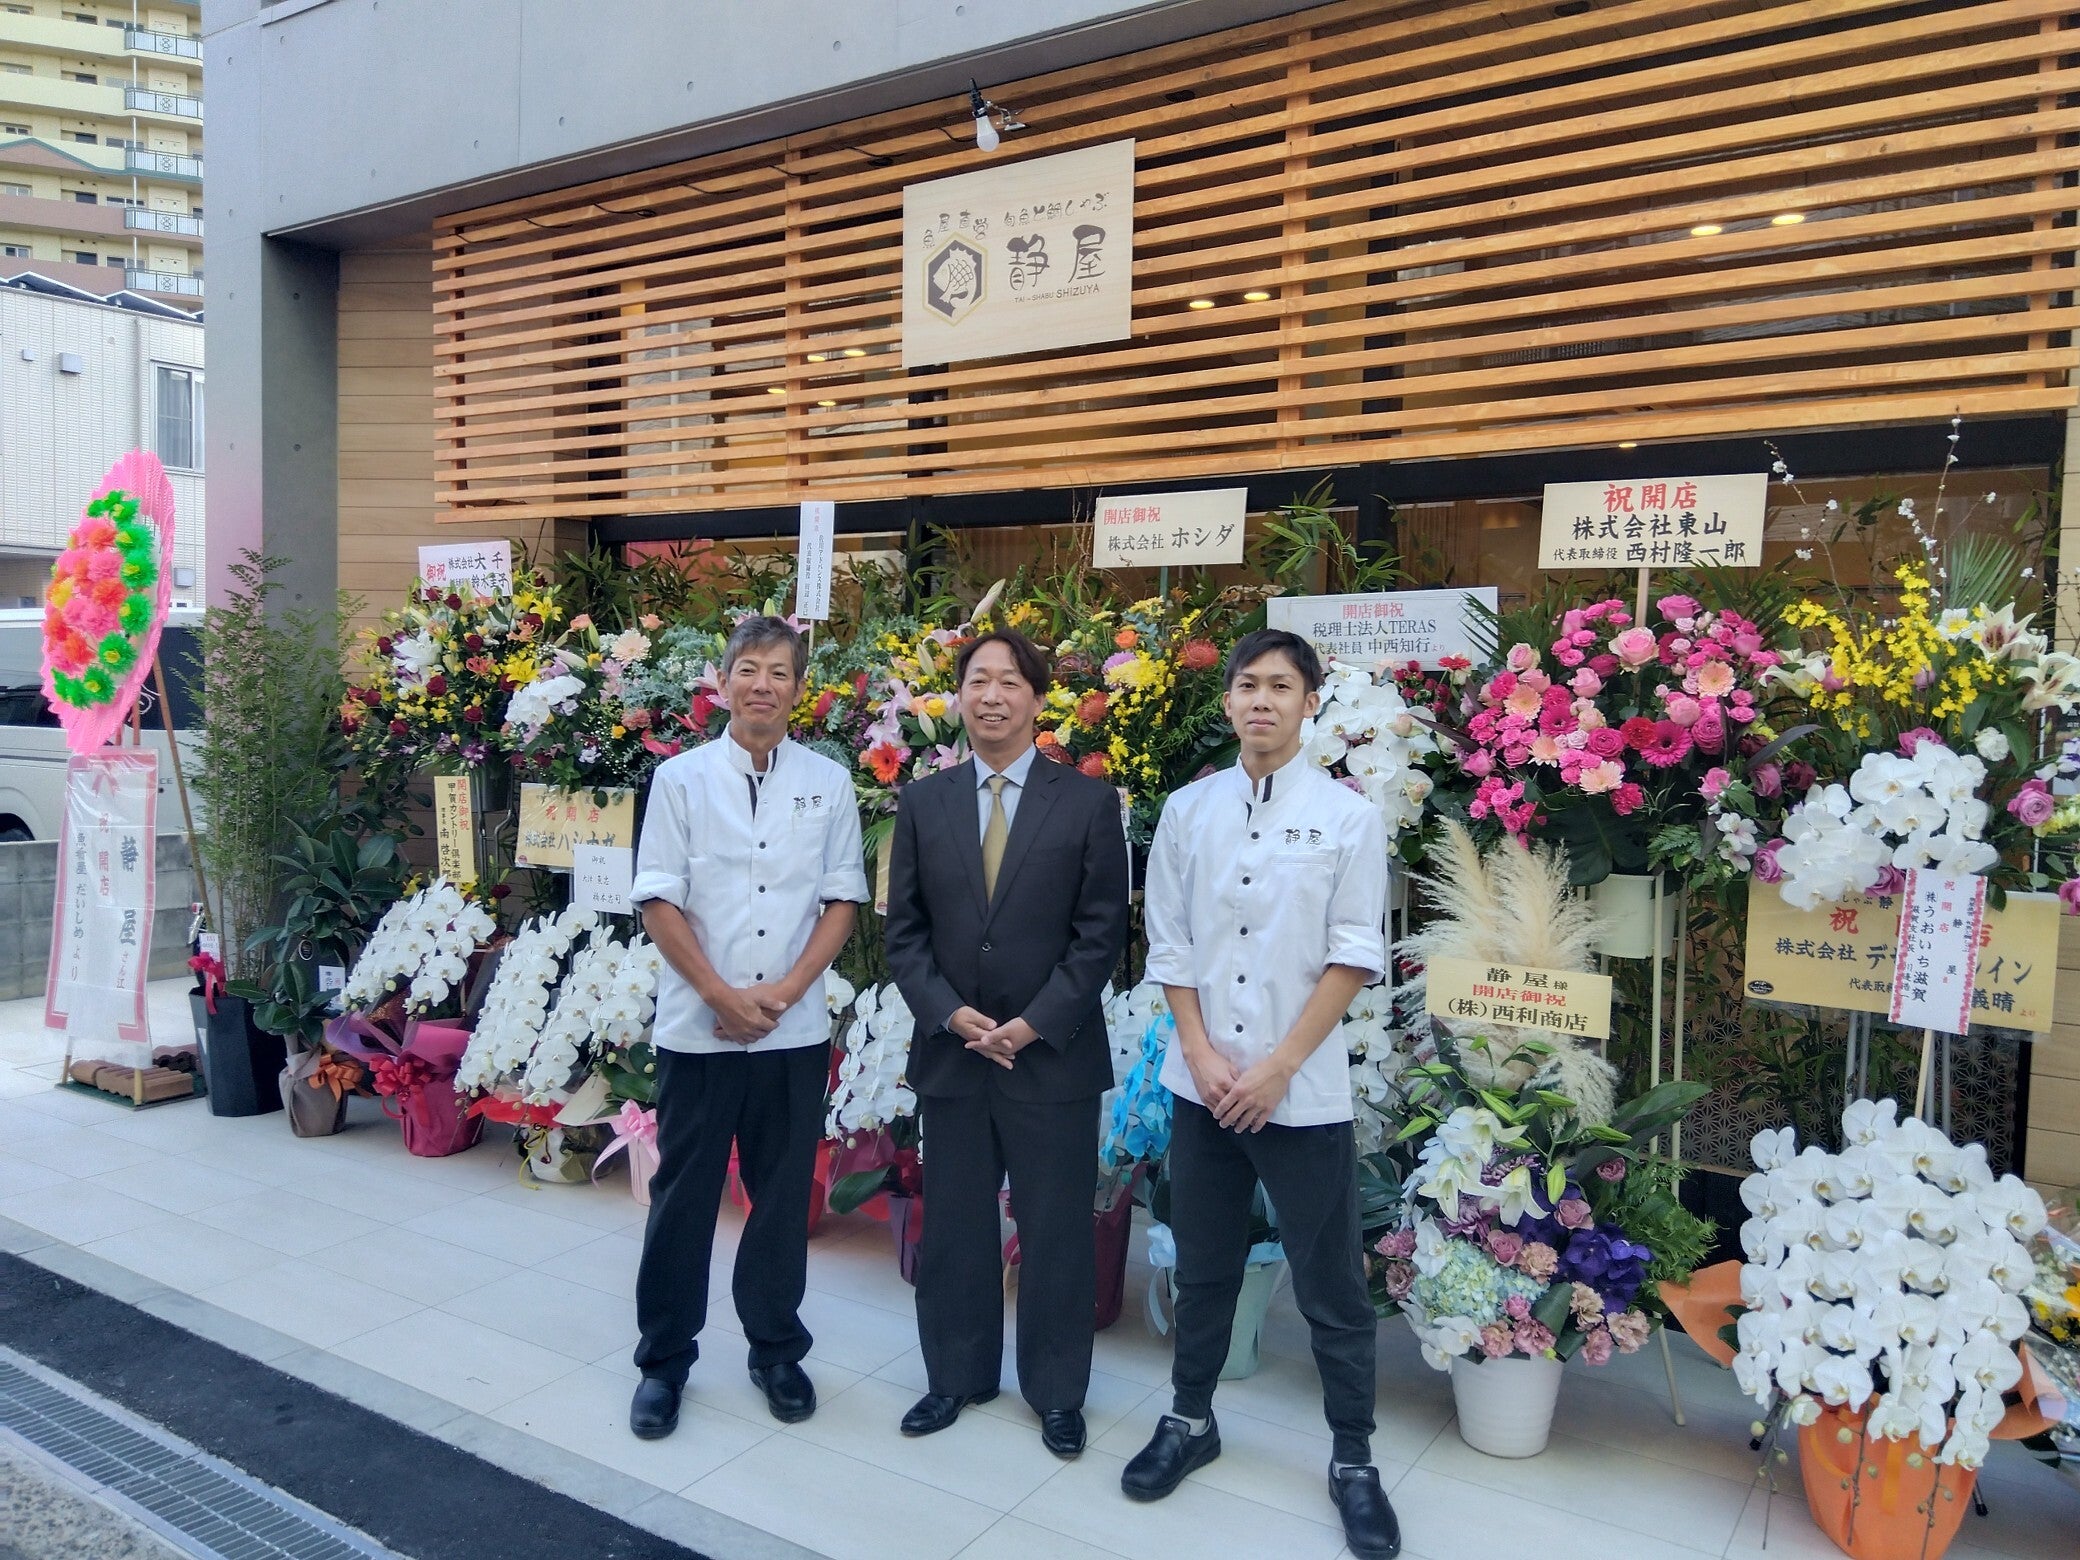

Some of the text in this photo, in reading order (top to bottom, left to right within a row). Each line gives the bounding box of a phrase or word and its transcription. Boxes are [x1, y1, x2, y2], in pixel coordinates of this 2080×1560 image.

[1006, 223, 1107, 292] 静屋
[1056, 283, 1100, 300] SHIZUYA
[1603, 481, 1699, 513] 祝開店
[1103, 505, 1162, 526] 開店御祝
[1571, 511, 1727, 541] 株式会社東山
[1107, 523, 1236, 552] 株式会社 ホシダ
[1552, 539, 1747, 564] 代表取締役 西村隆一郎
[1342, 602, 1405, 620] 開店御祝
[1312, 618, 1438, 638] 税理士法人TERAS
[1367, 637, 1431, 655] 中西知行
[457, 778, 470, 831] 開店御祝
[1285, 828, 1322, 846] 静屋
[1938, 880, 1956, 934] 祝開店
[1775, 937, 1857, 962] 株式会社
[1486, 967, 1569, 992] 静屋 様
[1472, 983, 1568, 1008] 開店御祝
[1447, 997, 1588, 1032] (株)西利商店
